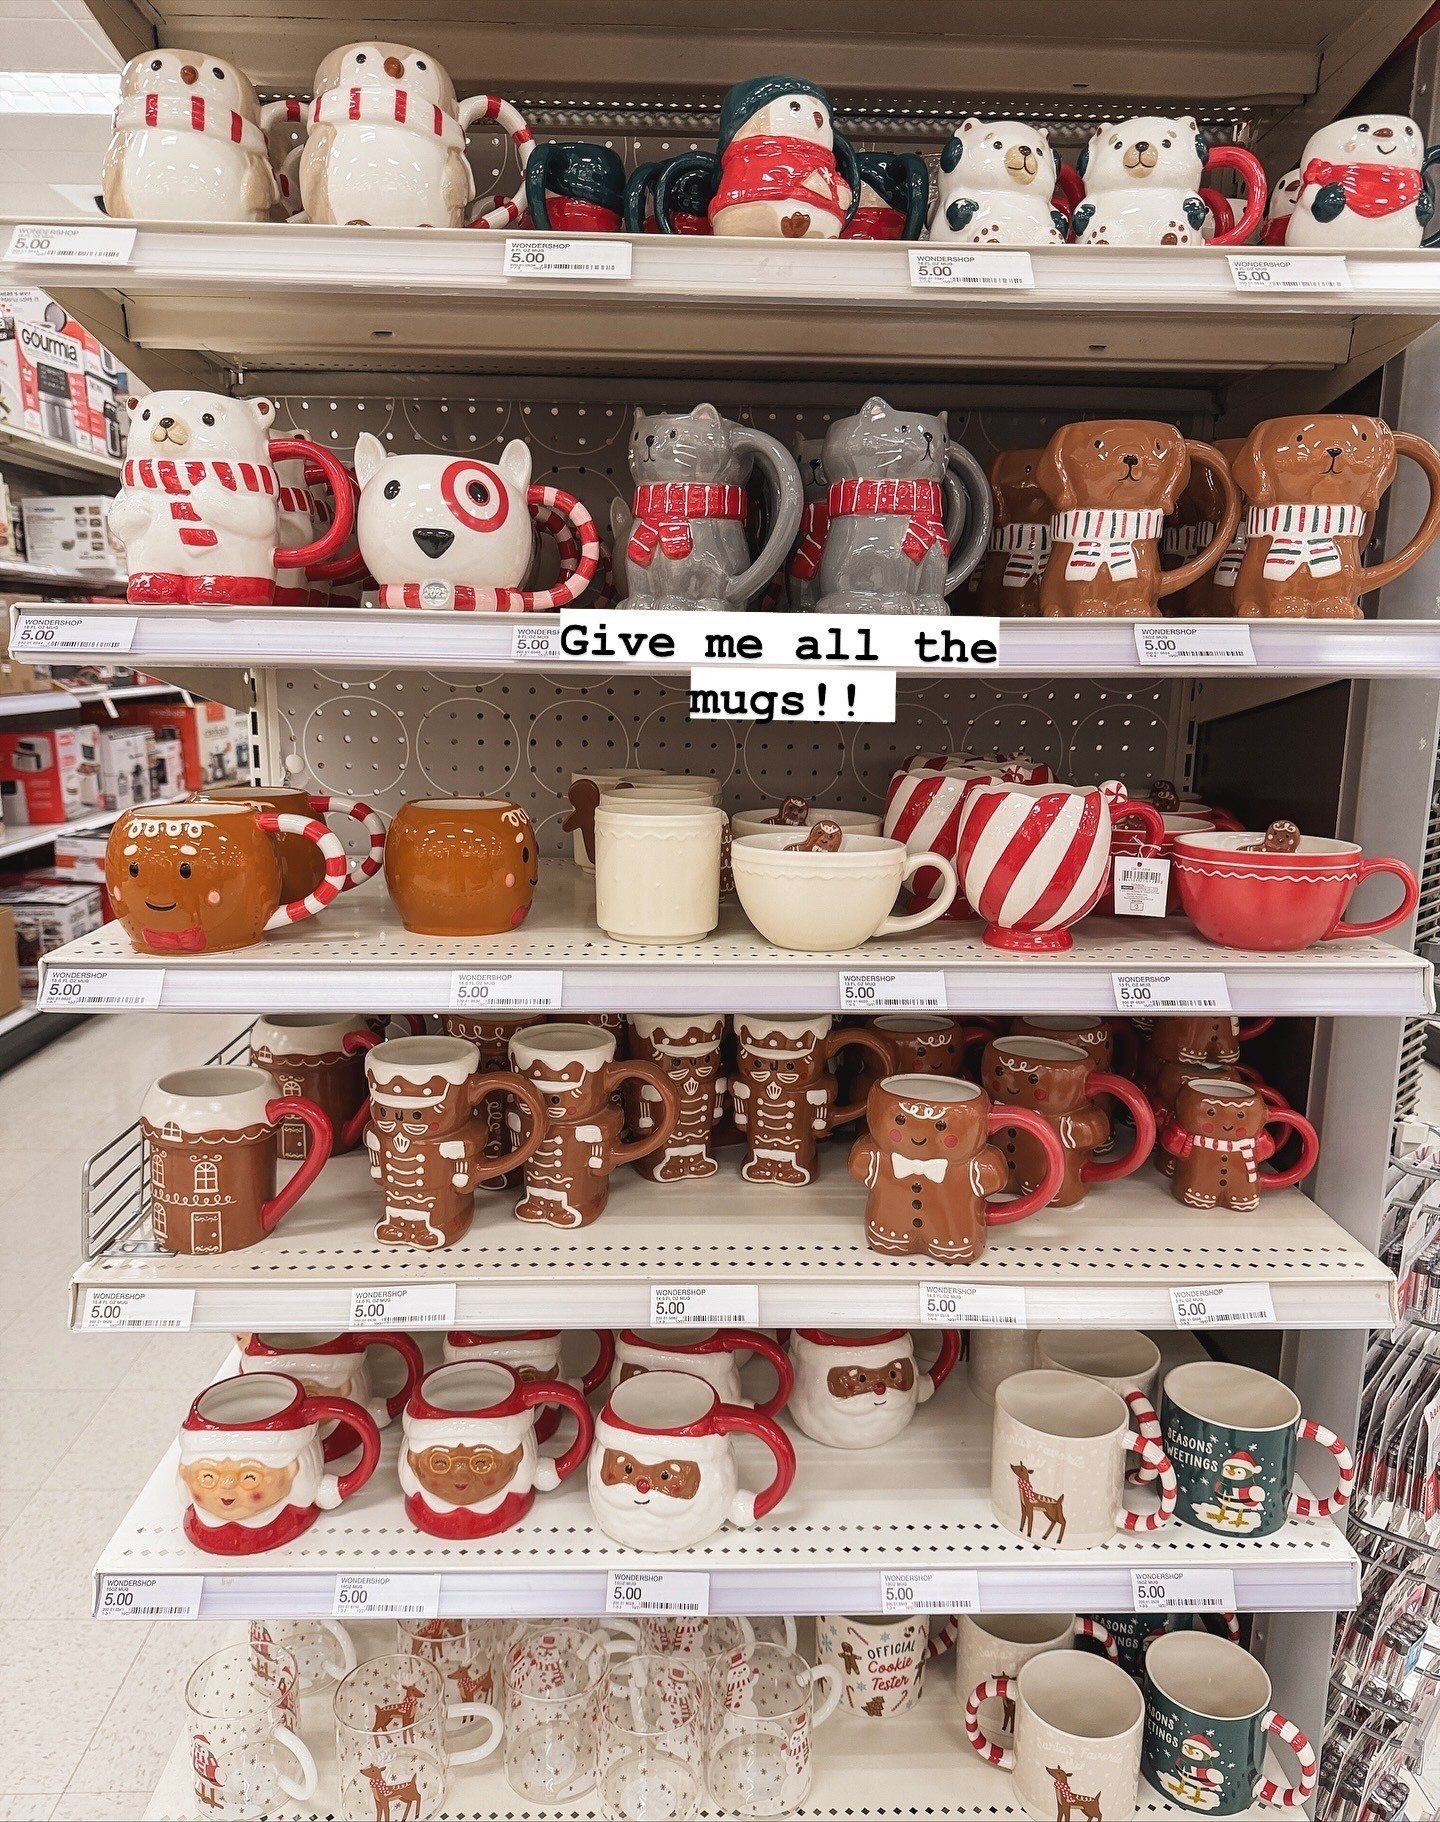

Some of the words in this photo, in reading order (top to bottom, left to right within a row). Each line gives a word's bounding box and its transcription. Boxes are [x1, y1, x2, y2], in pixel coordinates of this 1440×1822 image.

[15, 238, 50, 249] 5.00
[511, 253, 544, 263] 5.00
[919, 266, 952, 276] 5.00
[1238, 271, 1270, 280] 5.00
[22, 328, 78, 361] Gourmia
[21, 630, 54, 640] 5.00
[518, 640, 549, 649] 5.00
[1145, 640, 1176, 650] 5.00
[50, 984, 81, 995] 5.00
[458, 986, 488, 998] 5.00
[846, 987, 874, 998] 5.00
[1121, 988, 1151, 999] 5.00
[356, 1290, 407, 1298] WONDERSHOP
[927, 1286, 976, 1295] WONDERSHOP
[1174, 1289, 1223, 1298] WONDERSHOP
[355, 1304, 384, 1317] 5.00
[656, 1302, 684, 1314] 5.00
[928, 1299, 956, 1312] 5.00
[1178, 1303, 1206, 1316] 5.00
[91, 1306, 120, 1318] 5.00
[1168, 1427, 1213, 1454] SEASONS
[340, 1590, 367, 1603] 5.00
[614, 1587, 641, 1600] 5.00
[886, 1588, 913, 1600] 5.00
[1138, 1586, 1165, 1598] 5.00
[105, 1593, 133, 1606] 5.00
[868, 1640, 916, 1660] OFFICIAL
[868, 1656, 912, 1674] Cookie
[872, 1674, 910, 1690] Tester
